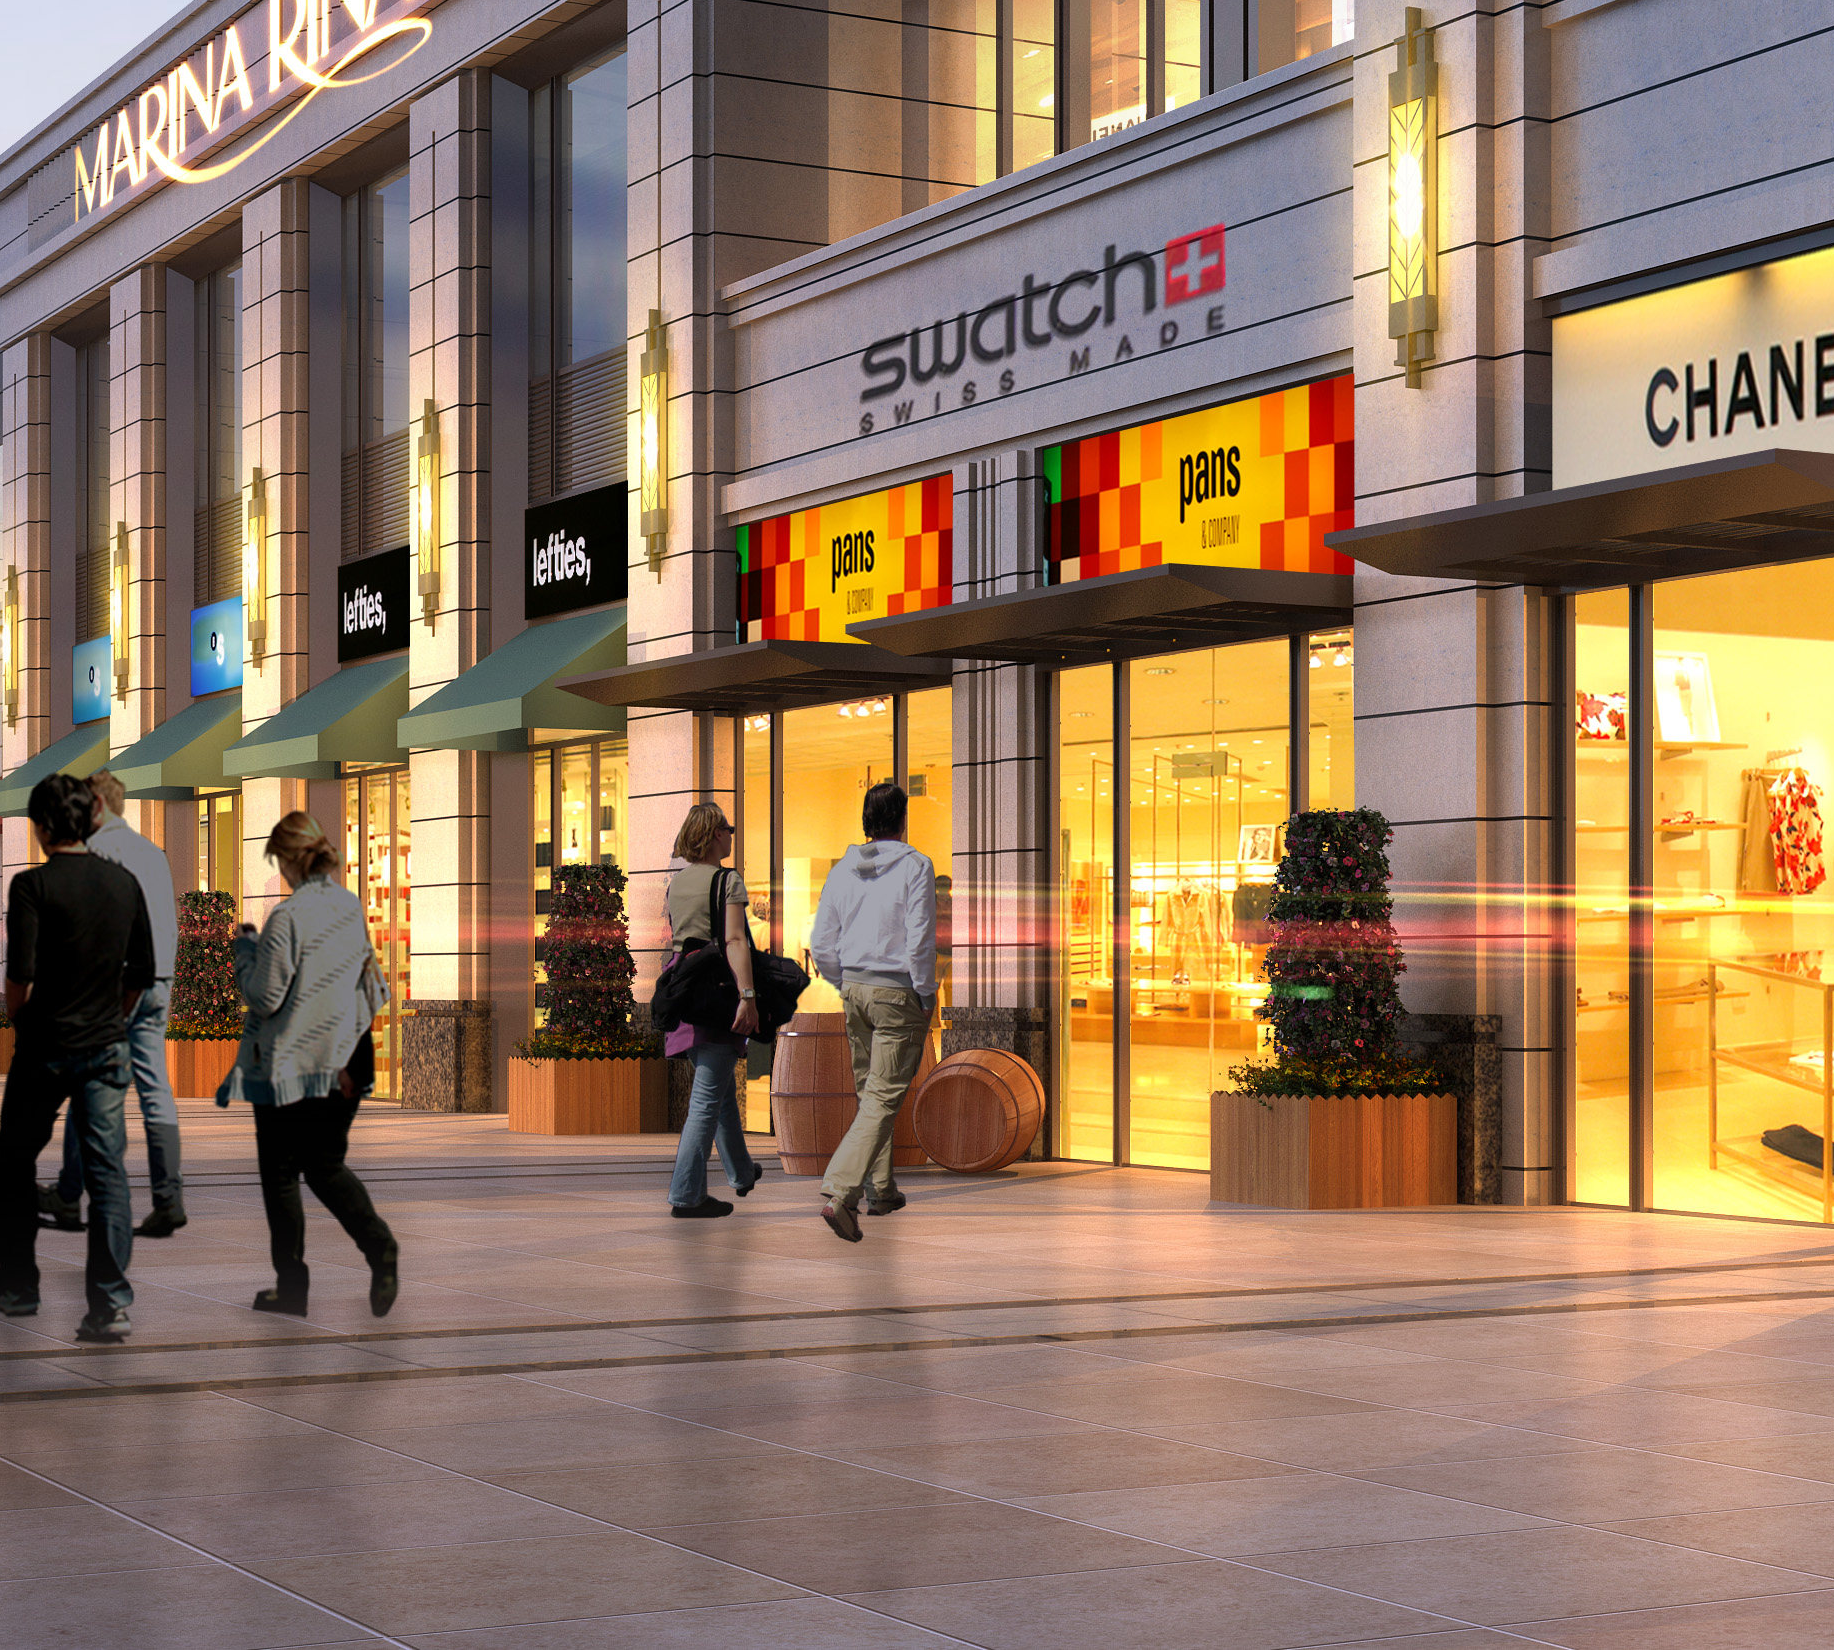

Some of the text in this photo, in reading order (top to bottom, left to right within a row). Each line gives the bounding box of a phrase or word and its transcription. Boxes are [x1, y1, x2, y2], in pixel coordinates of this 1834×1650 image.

[75, 26, 254, 223] MARINA
[859, 243, 1157, 403] swatch
[859, 304, 1226, 435] SWISS MADE
[1180, 445, 1241, 524] pans
[533, 528, 592, 587] lefties,
[832, 529, 875, 594] pans
[1208, 514, 1241, 546] COMPANY
[343, 584, 386, 636] lefties,
